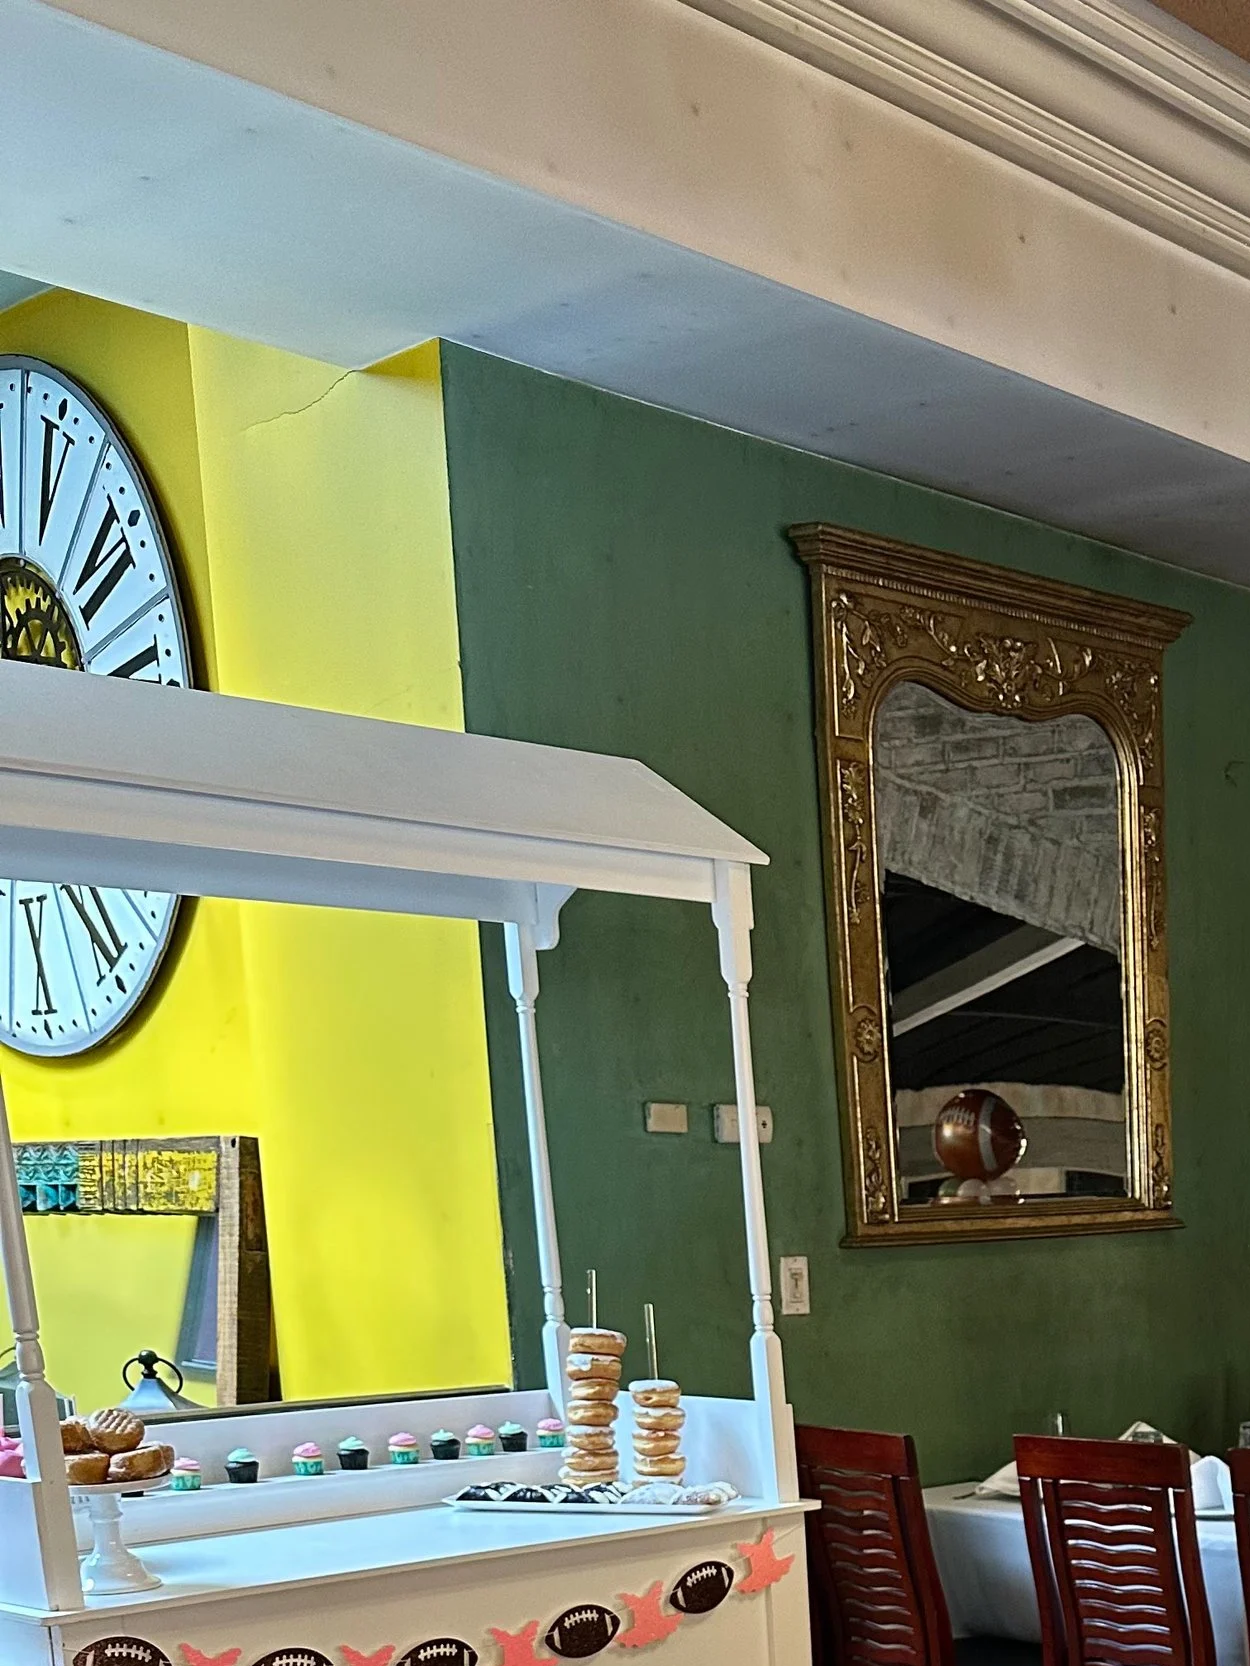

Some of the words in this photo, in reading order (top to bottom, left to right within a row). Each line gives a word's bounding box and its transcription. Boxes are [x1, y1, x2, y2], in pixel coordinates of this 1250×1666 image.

[39, 414, 75, 546] V
[73, 493, 136, 631] VI
[19, 894, 57, 1015] X
